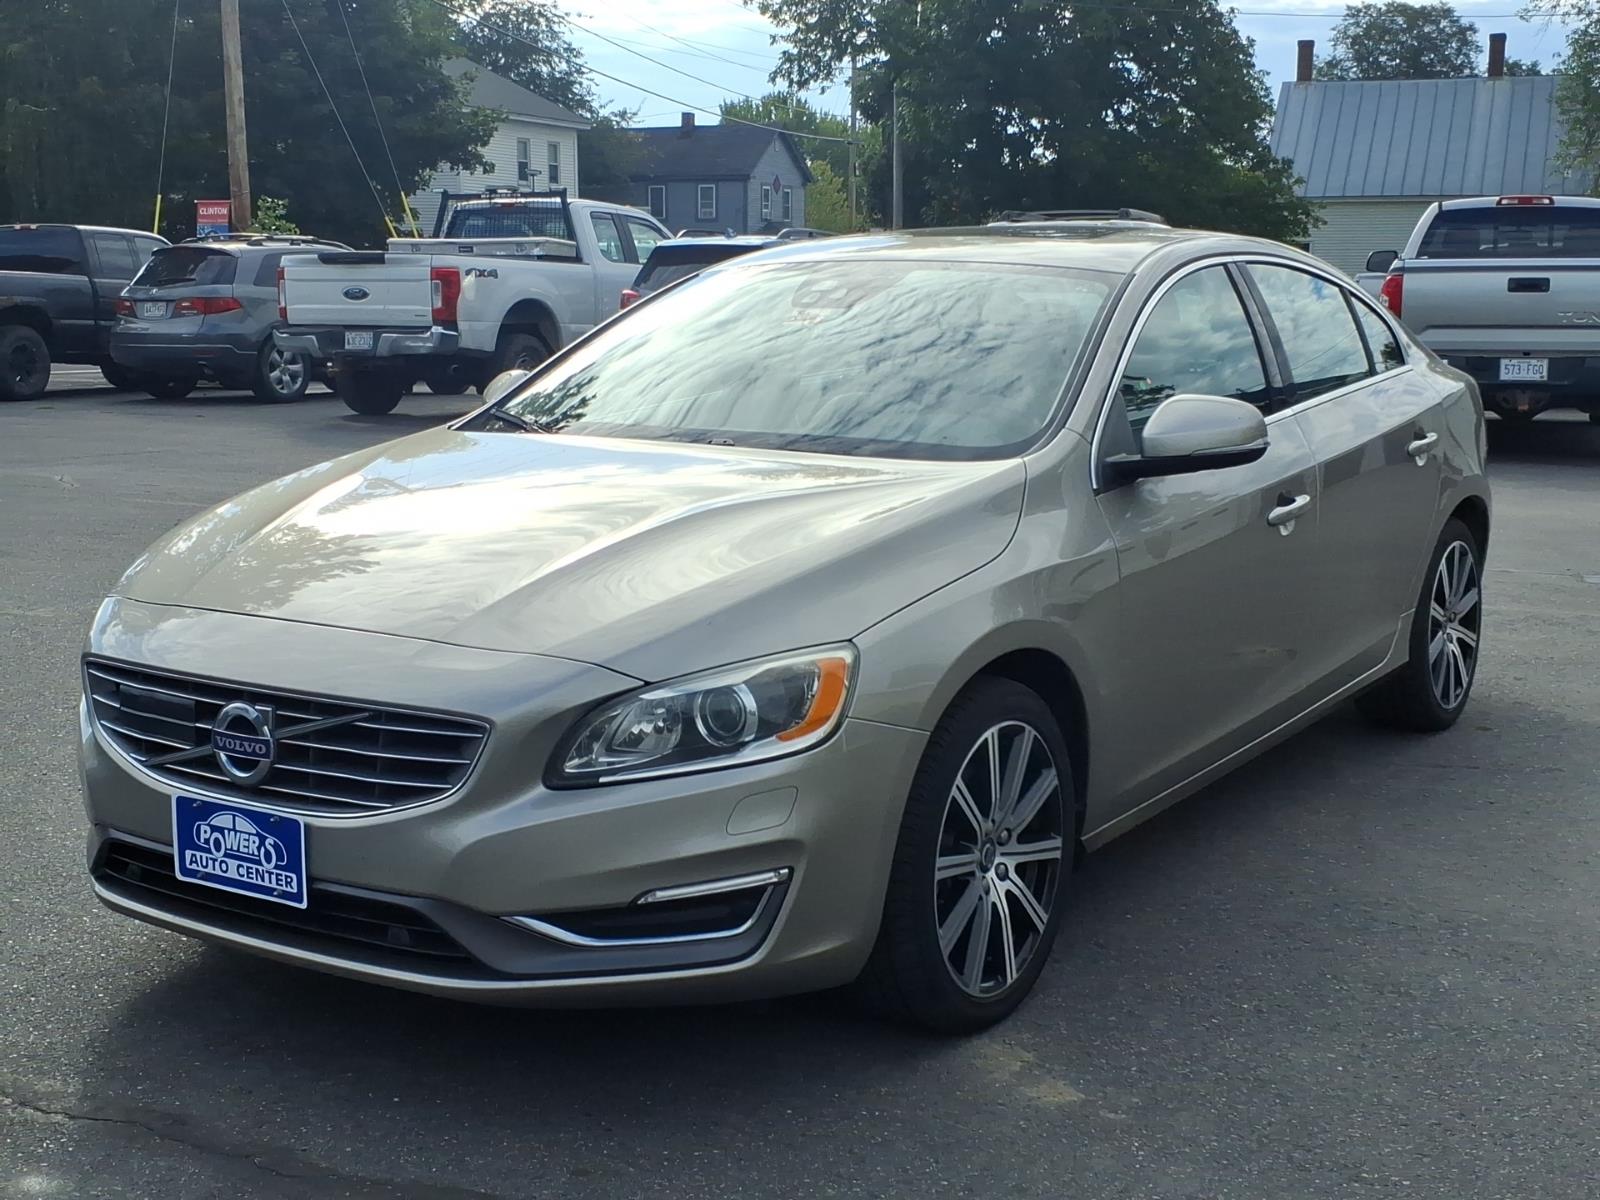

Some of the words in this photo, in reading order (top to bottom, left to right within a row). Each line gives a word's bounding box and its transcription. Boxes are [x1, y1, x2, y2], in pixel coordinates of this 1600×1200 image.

[199, 207, 228, 215] CLINTON
[215, 736, 266, 754] VOLVO
[188, 853, 229, 873] AUTO
[236, 863, 294, 889] CENTER
